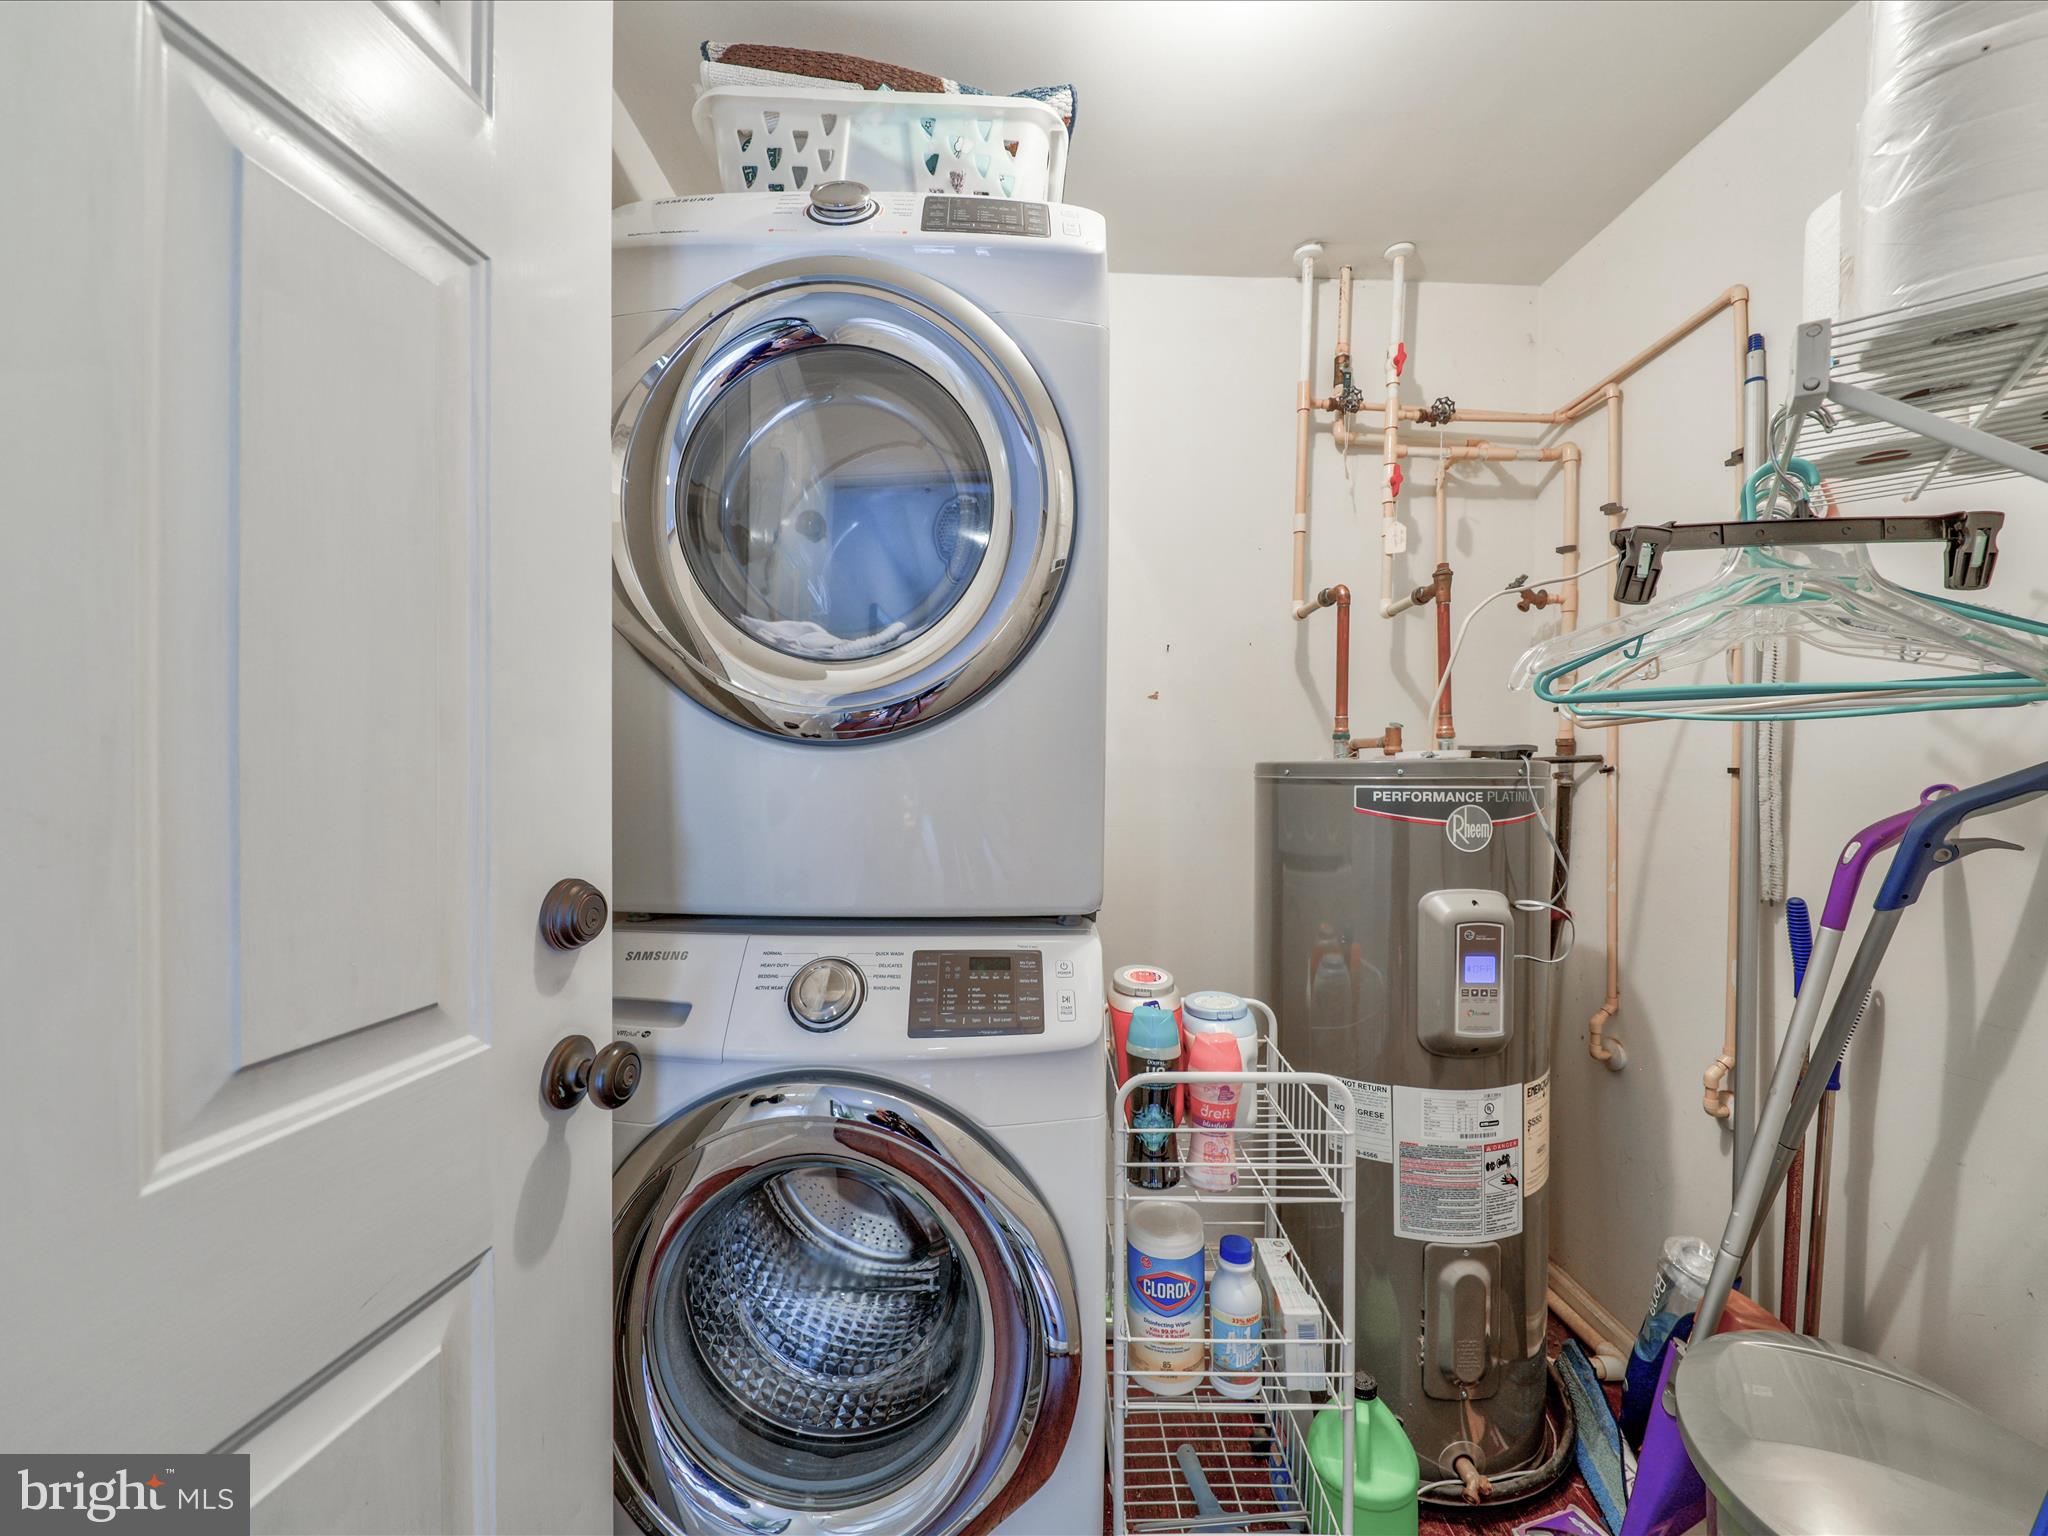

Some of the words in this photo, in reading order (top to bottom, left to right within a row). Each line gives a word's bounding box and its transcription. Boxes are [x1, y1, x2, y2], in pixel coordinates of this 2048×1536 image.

[1373, 791, 1483, 803] PERFORMANCE
[1452, 806, 1490, 845] Rheem
[625, 951, 689, 961] SAMSUNG
[1357, 1083, 1388, 1093] RETURN
[1200, 1104, 1232, 1120] dreft
[1355, 1108, 1385, 1120] GRESE
[1143, 1278, 1191, 1300] CLOROX
[1143, 1317, 1174, 1329] Disinfecting
[1162, 1361, 1172, 1369] 85
